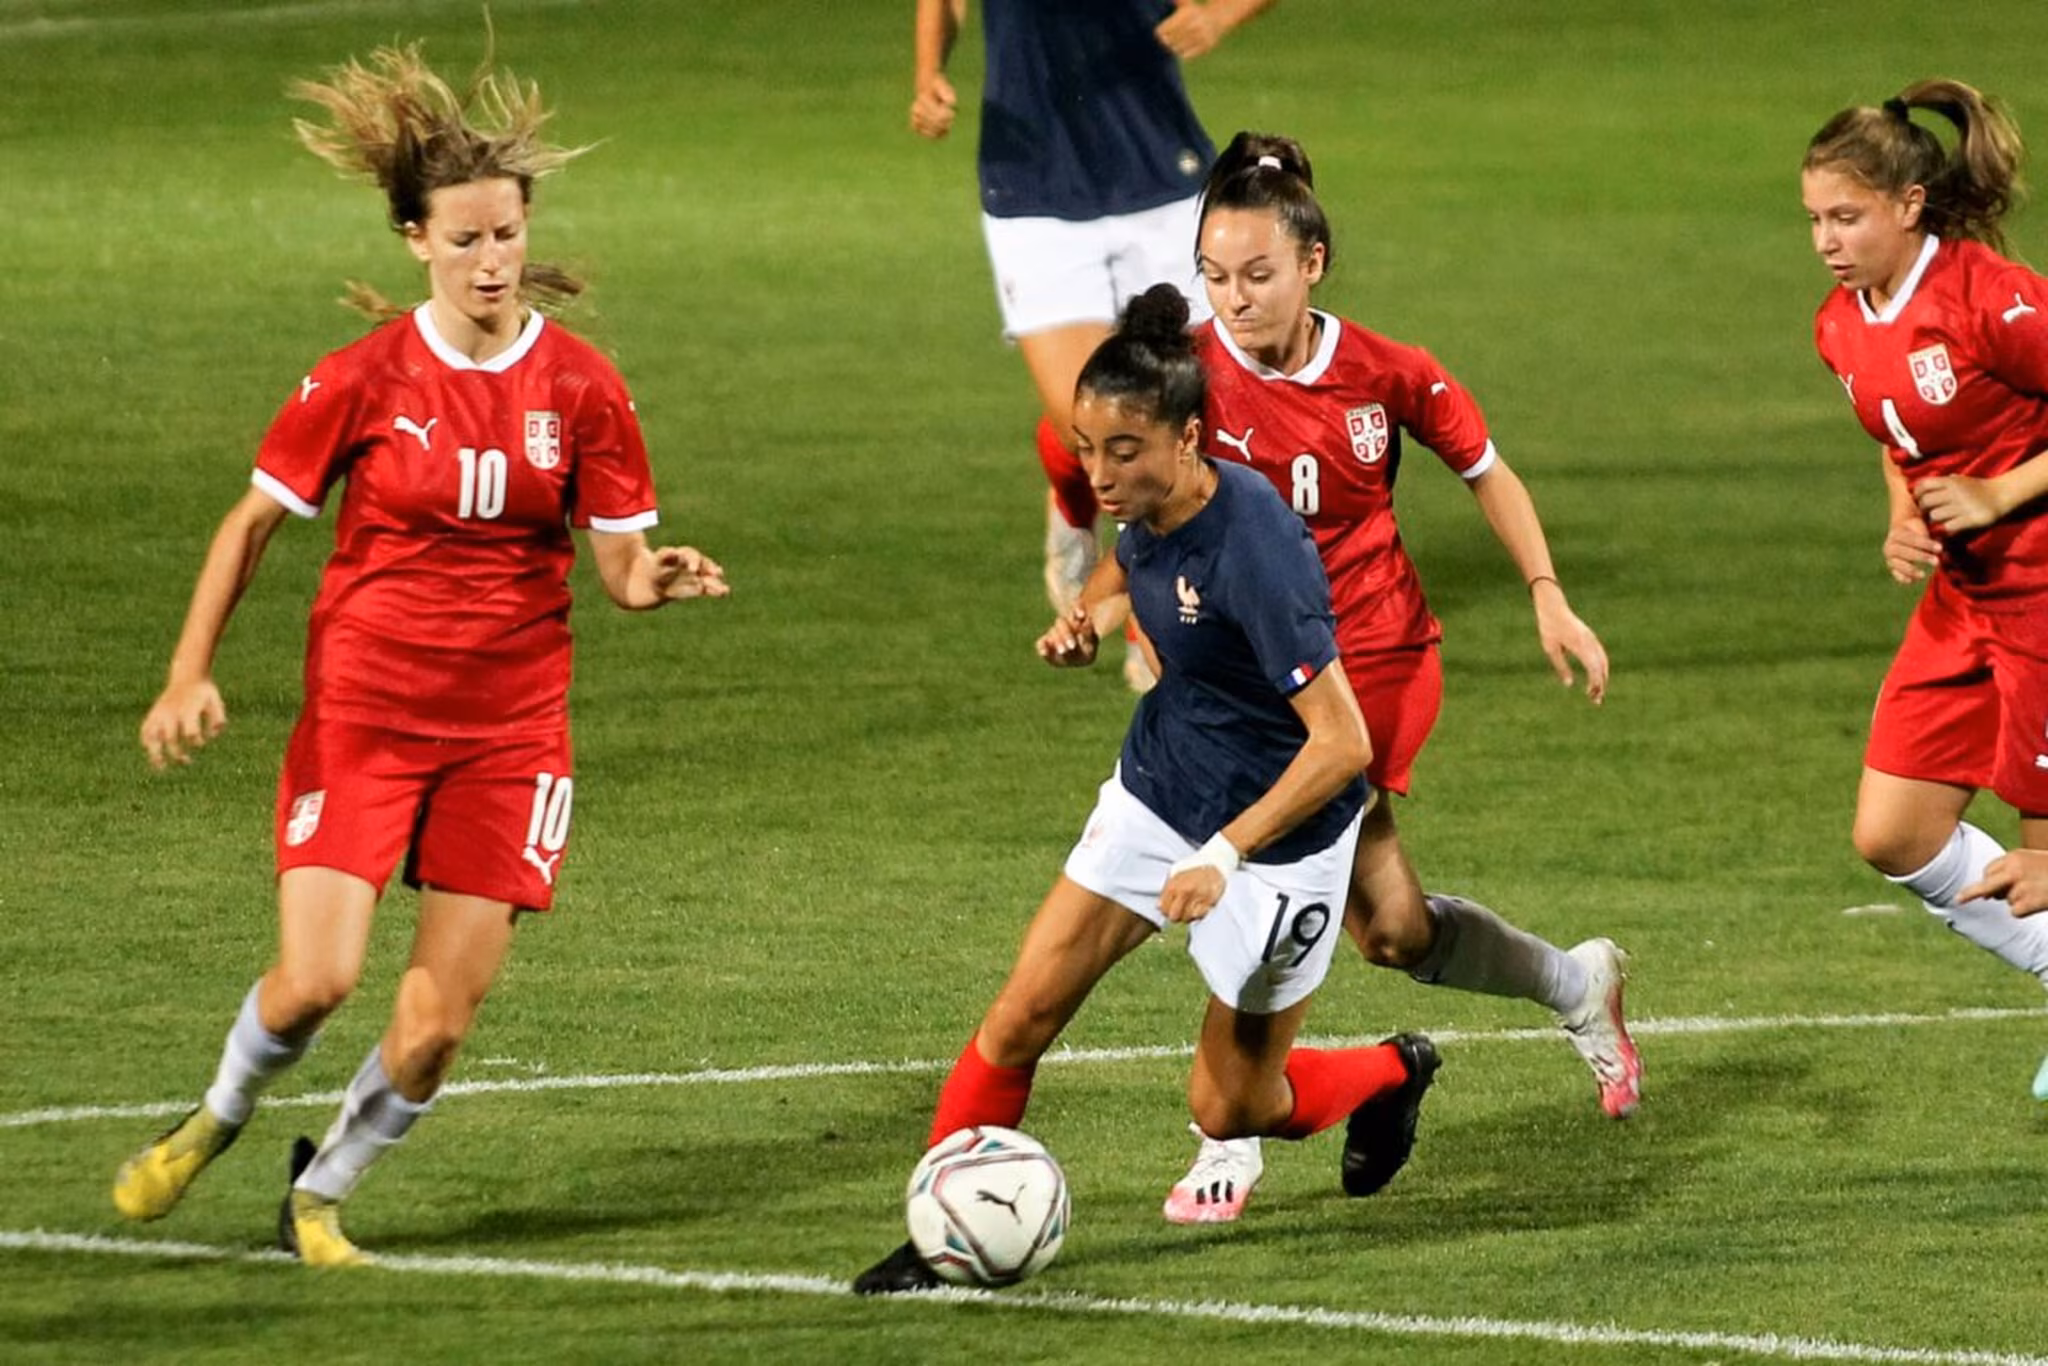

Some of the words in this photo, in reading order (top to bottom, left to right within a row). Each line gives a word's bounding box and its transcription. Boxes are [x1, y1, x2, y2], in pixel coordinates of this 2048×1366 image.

[458, 448, 507, 519] 10
[1291, 454, 1319, 515] 8
[526, 772, 573, 852] 10
[1261, 892, 1330, 967] 19
